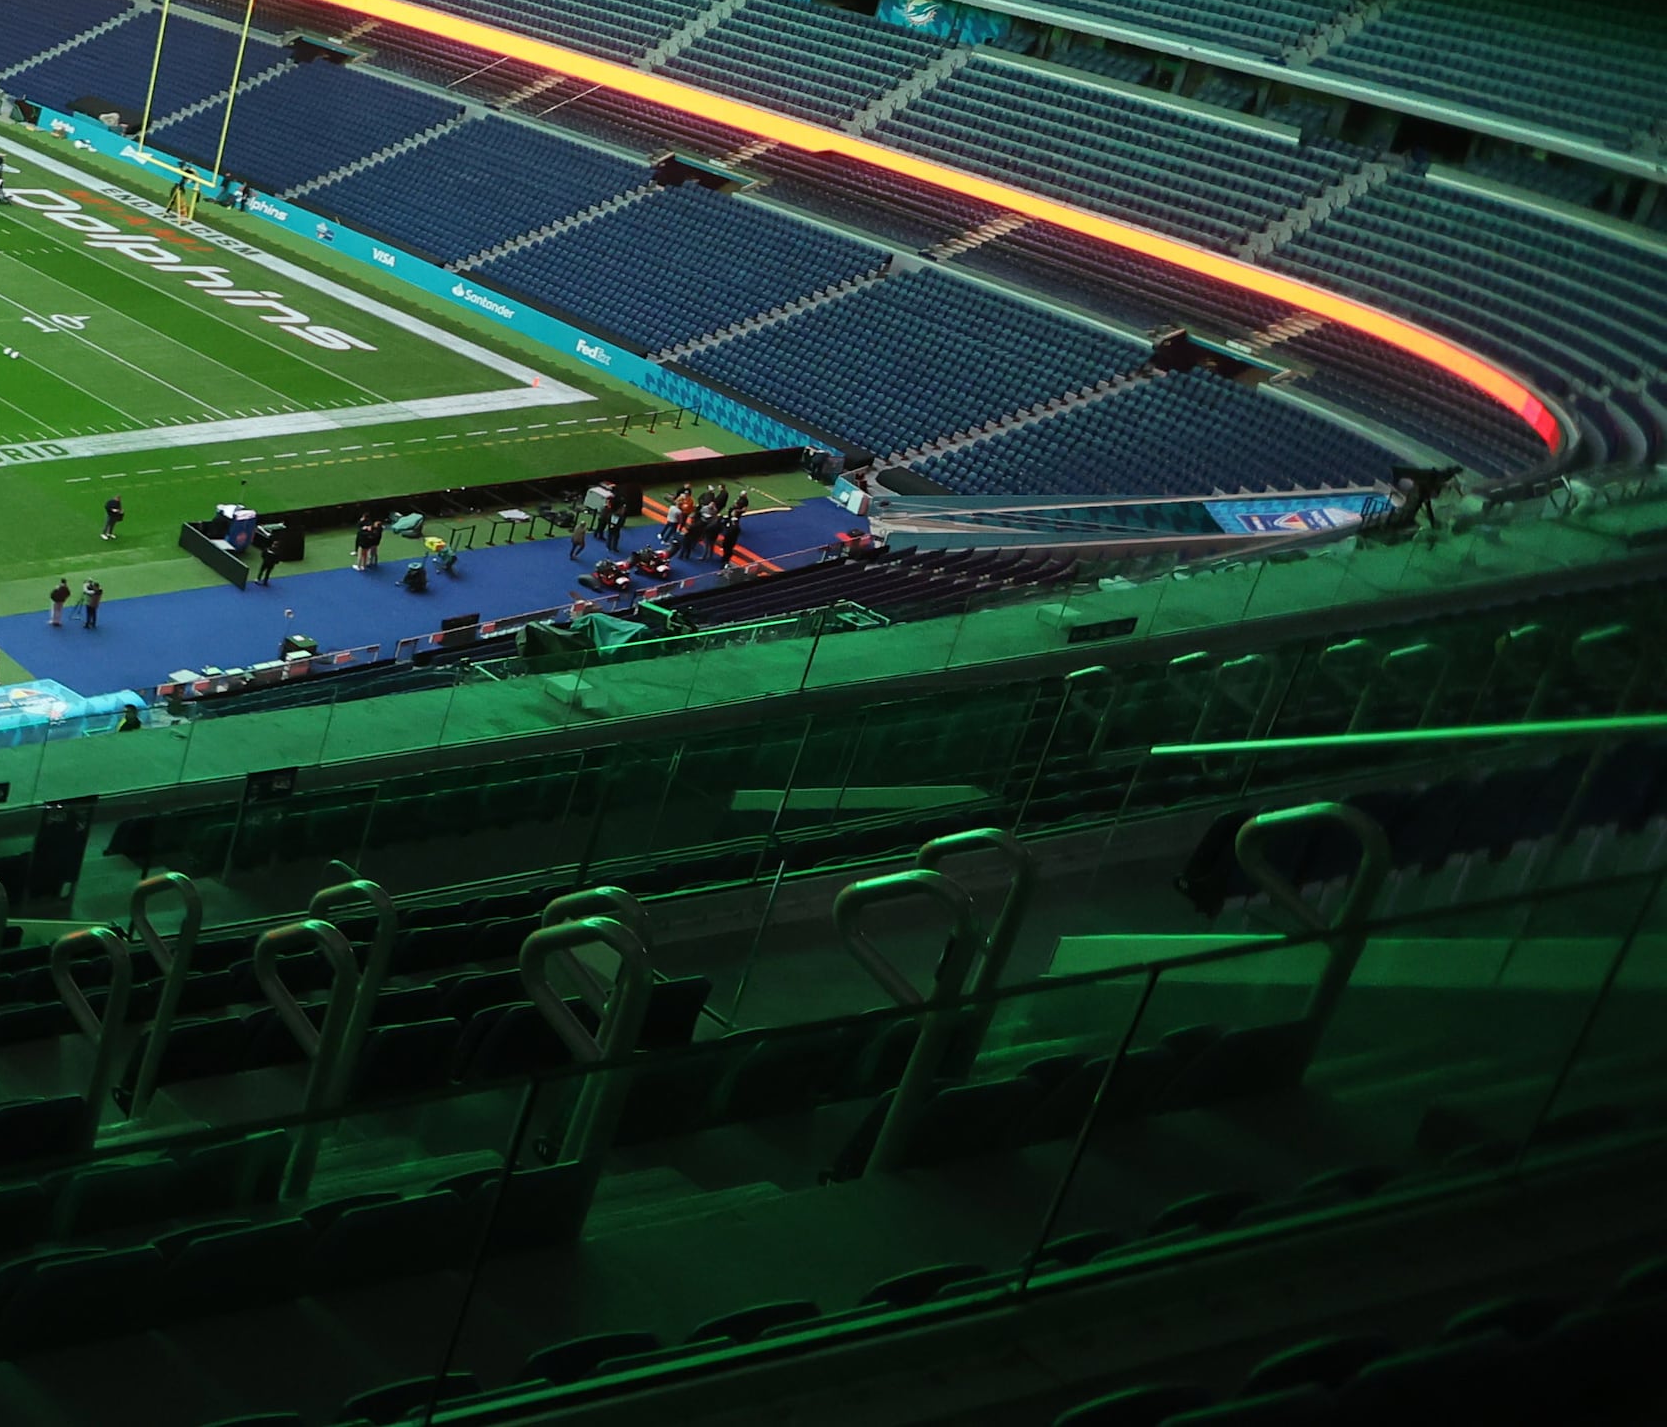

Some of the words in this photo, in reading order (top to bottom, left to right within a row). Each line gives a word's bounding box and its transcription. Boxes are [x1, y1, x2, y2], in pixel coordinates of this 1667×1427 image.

[63, 189, 214, 252] MIAMI
[234, 190, 289, 222] Dlphins
[101, 188, 153, 209] END
[157, 210, 262, 257] RACISM
[3, 186, 377, 352] Dolphins
[372, 247, 396, 267] VISA
[464, 289, 515, 319] Santander
[21, 314, 84, 334] 10
[576, 339, 612, 365] FedEx
